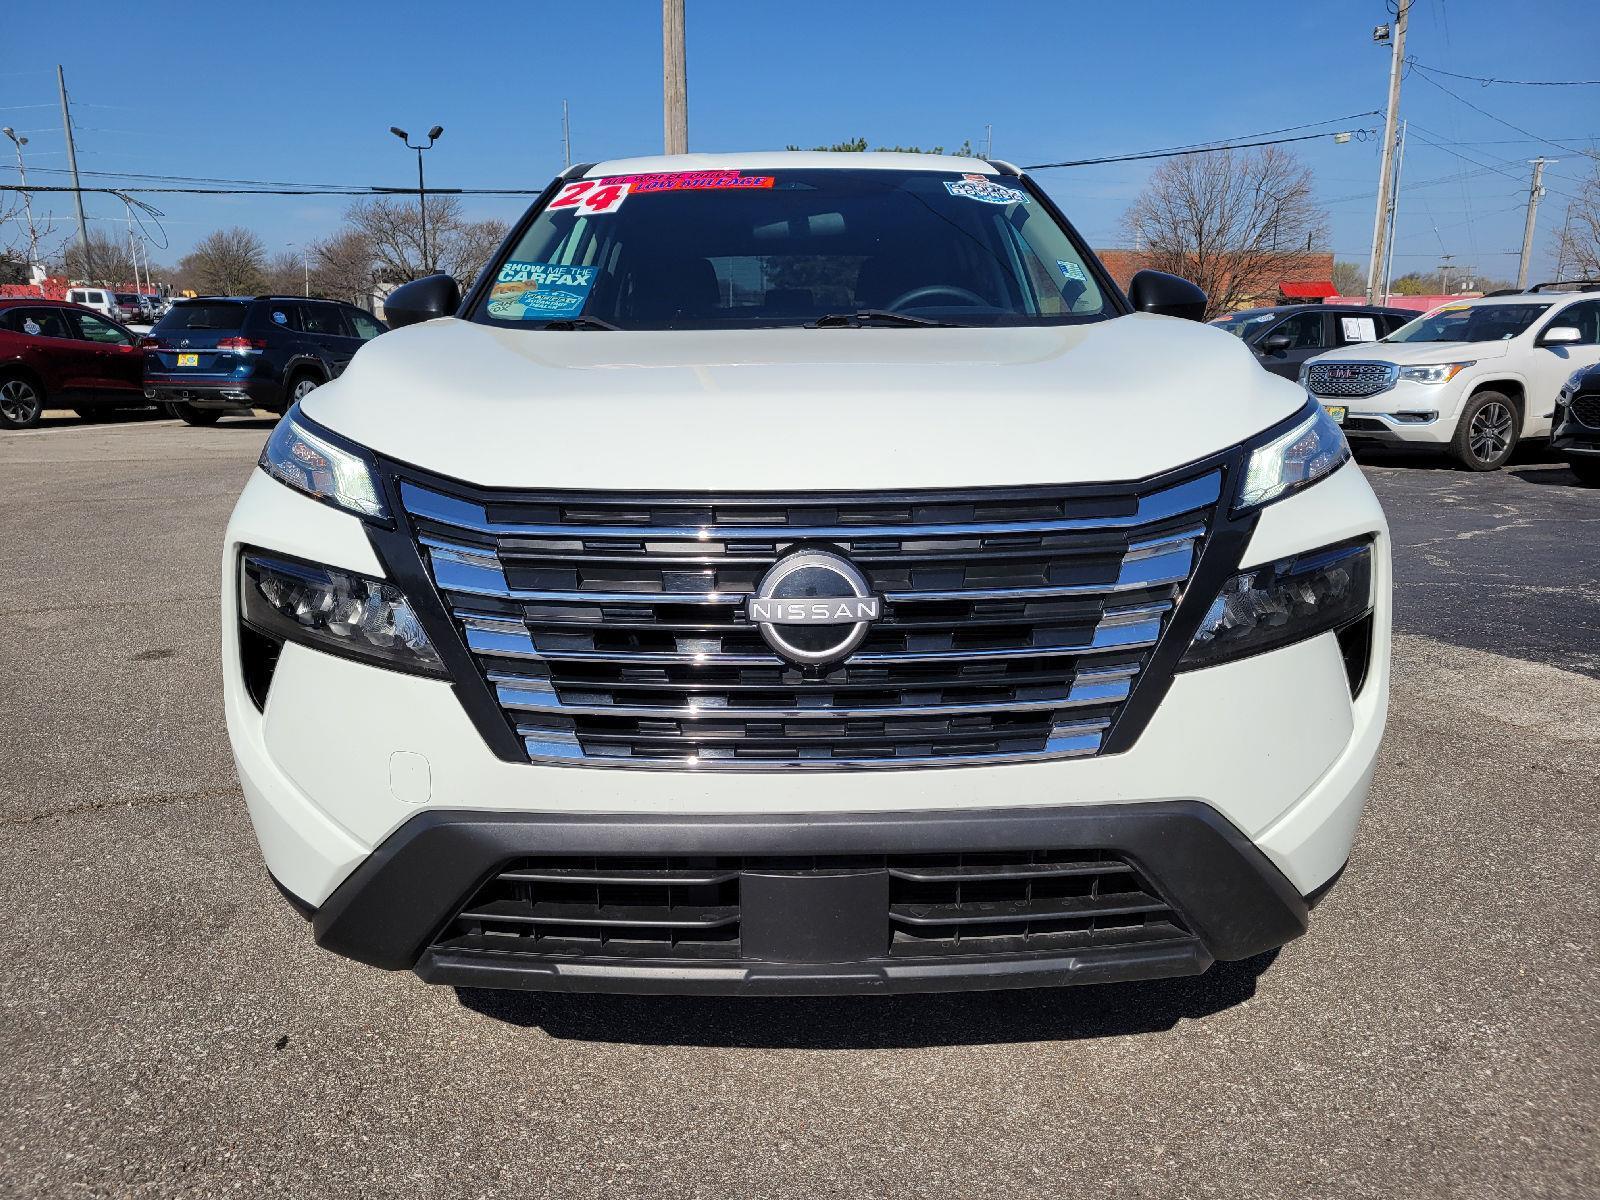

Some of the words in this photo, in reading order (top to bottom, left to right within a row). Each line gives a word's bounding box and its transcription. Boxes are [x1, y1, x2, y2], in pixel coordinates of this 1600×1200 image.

[635, 179, 678, 191] LOW
[680, 176, 768, 188] MILEAGE
[549, 181, 624, 212] 24
[501, 263, 546, 273] SHOW
[547, 266, 567, 275] ME
[570, 267, 594, 276] THE
[498, 270, 591, 286] CARFAX
[1327, 368, 1357, 379] GMC
[752, 601, 877, 620] NISSAN
